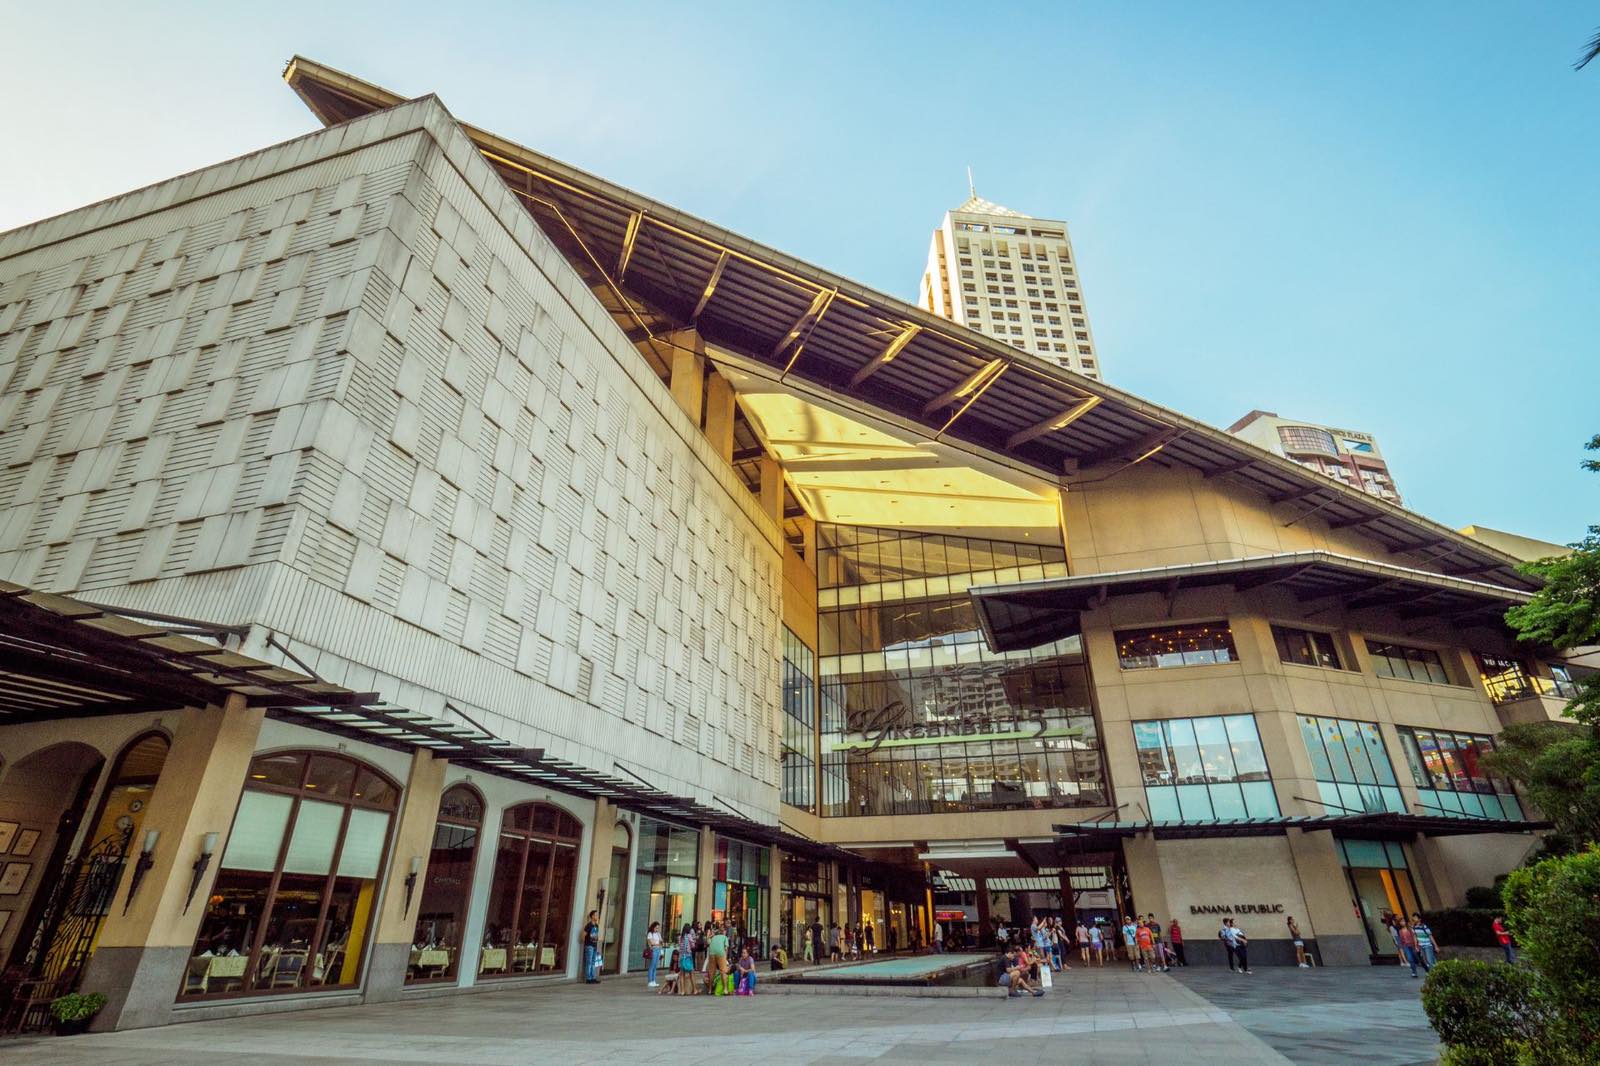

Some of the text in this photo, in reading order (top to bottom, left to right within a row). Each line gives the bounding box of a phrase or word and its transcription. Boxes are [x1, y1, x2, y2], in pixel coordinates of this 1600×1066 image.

[844, 701, 1048, 757] GREENBELT 5
[1190, 903, 1285, 915] BANANA REPUBLIC
